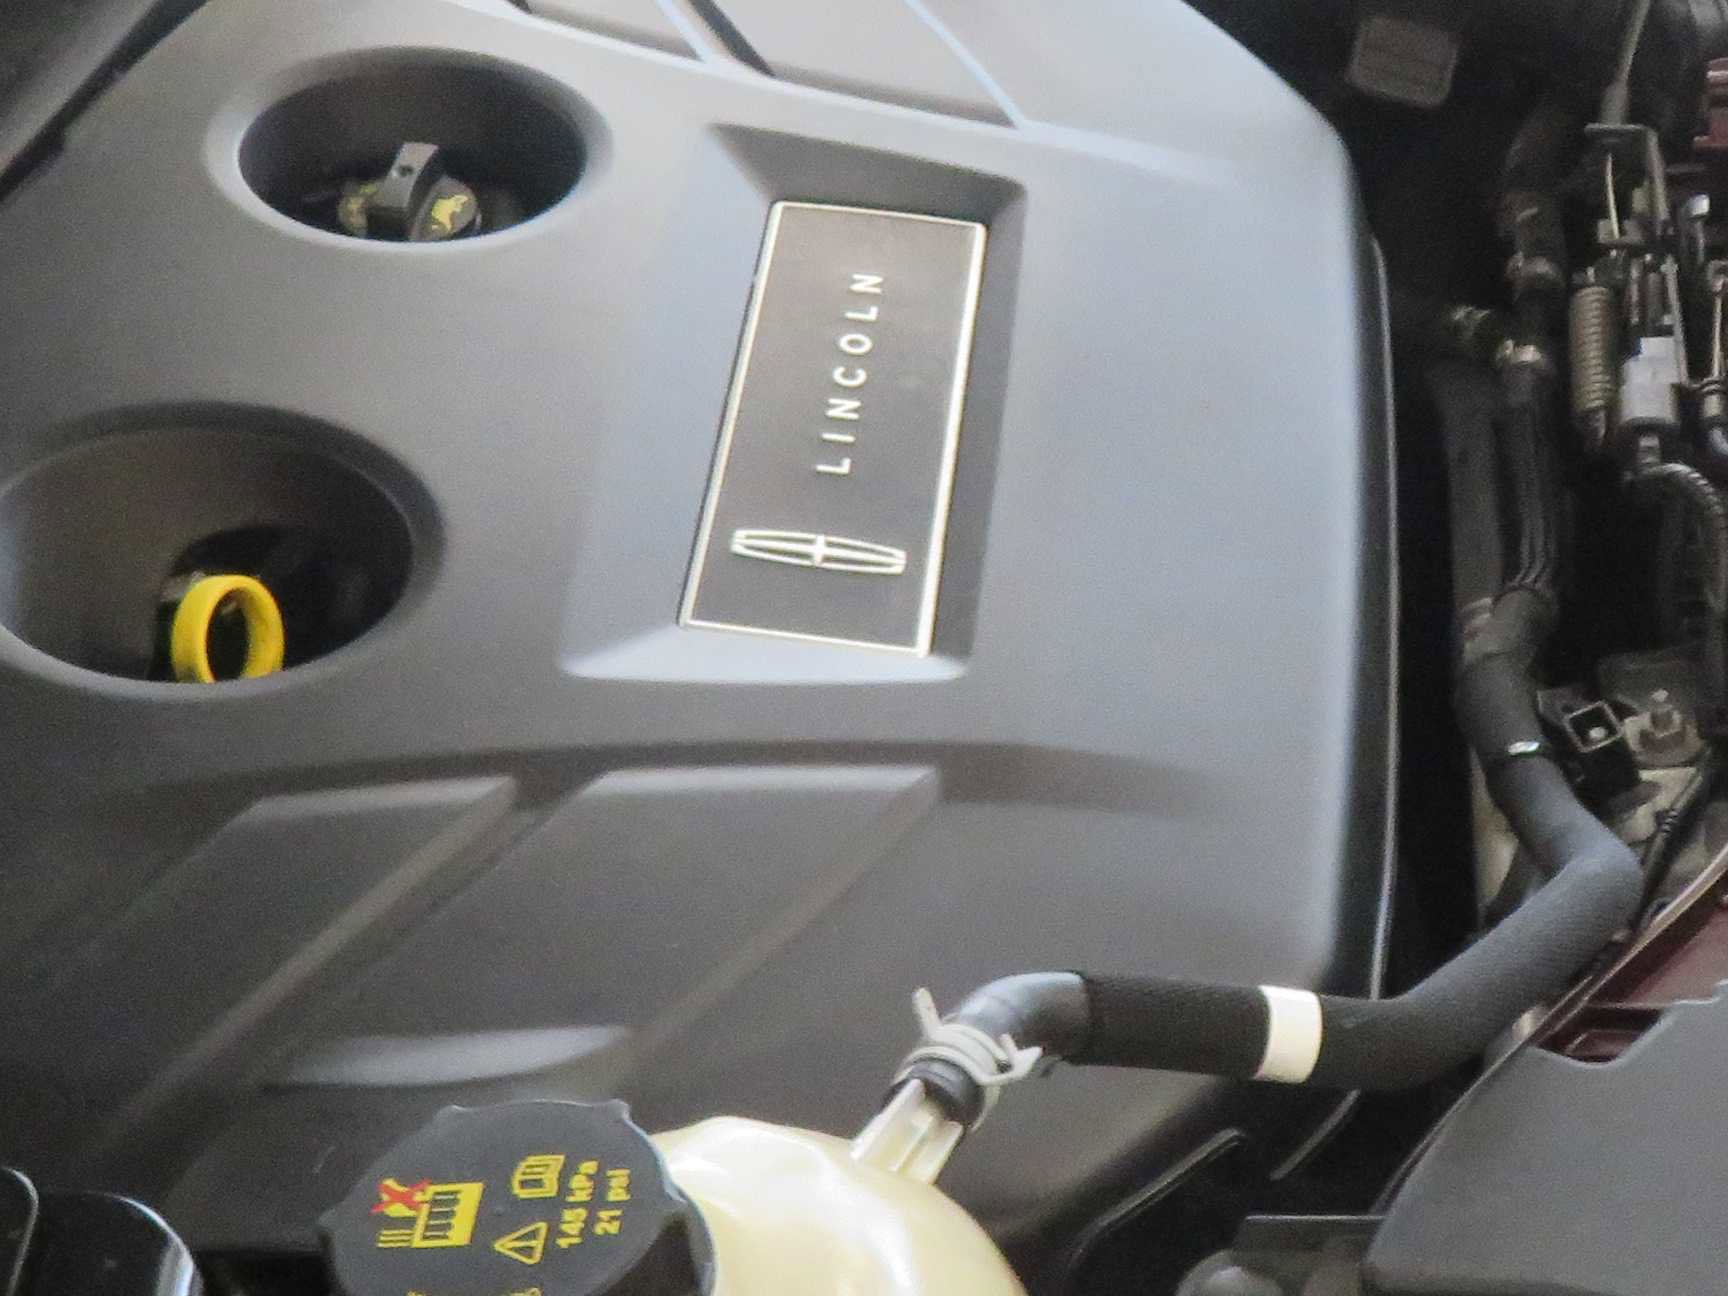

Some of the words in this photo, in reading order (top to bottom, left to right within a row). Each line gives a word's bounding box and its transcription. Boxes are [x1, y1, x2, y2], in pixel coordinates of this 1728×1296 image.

[815, 272, 884, 475] LINCOLN
[555, 1207, 588, 1248] 145
[593, 1209, 624, 1235] 21
